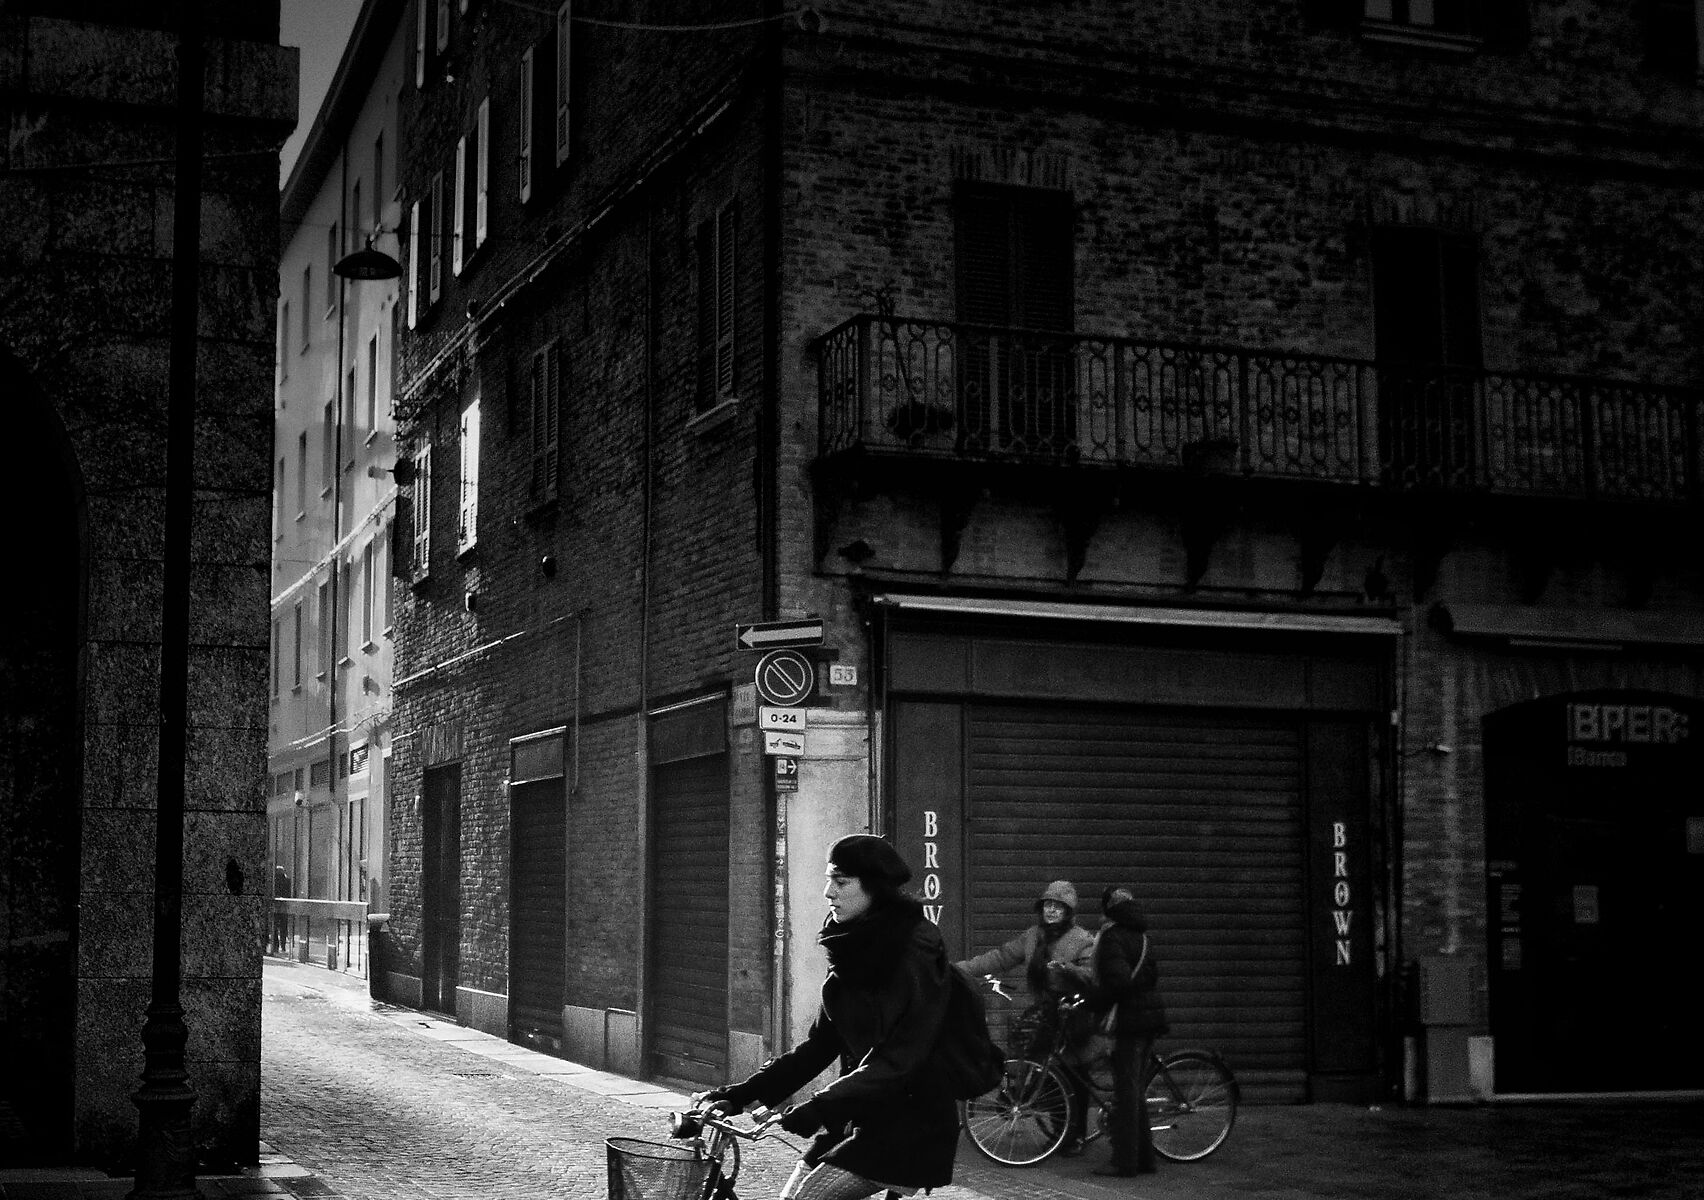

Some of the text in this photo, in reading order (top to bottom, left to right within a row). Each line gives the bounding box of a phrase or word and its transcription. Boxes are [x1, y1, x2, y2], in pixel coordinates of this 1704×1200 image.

[770, 713, 797, 723] 0-24
[923, 811, 943, 926] BROW
[1333, 822, 1353, 966] BROWN
